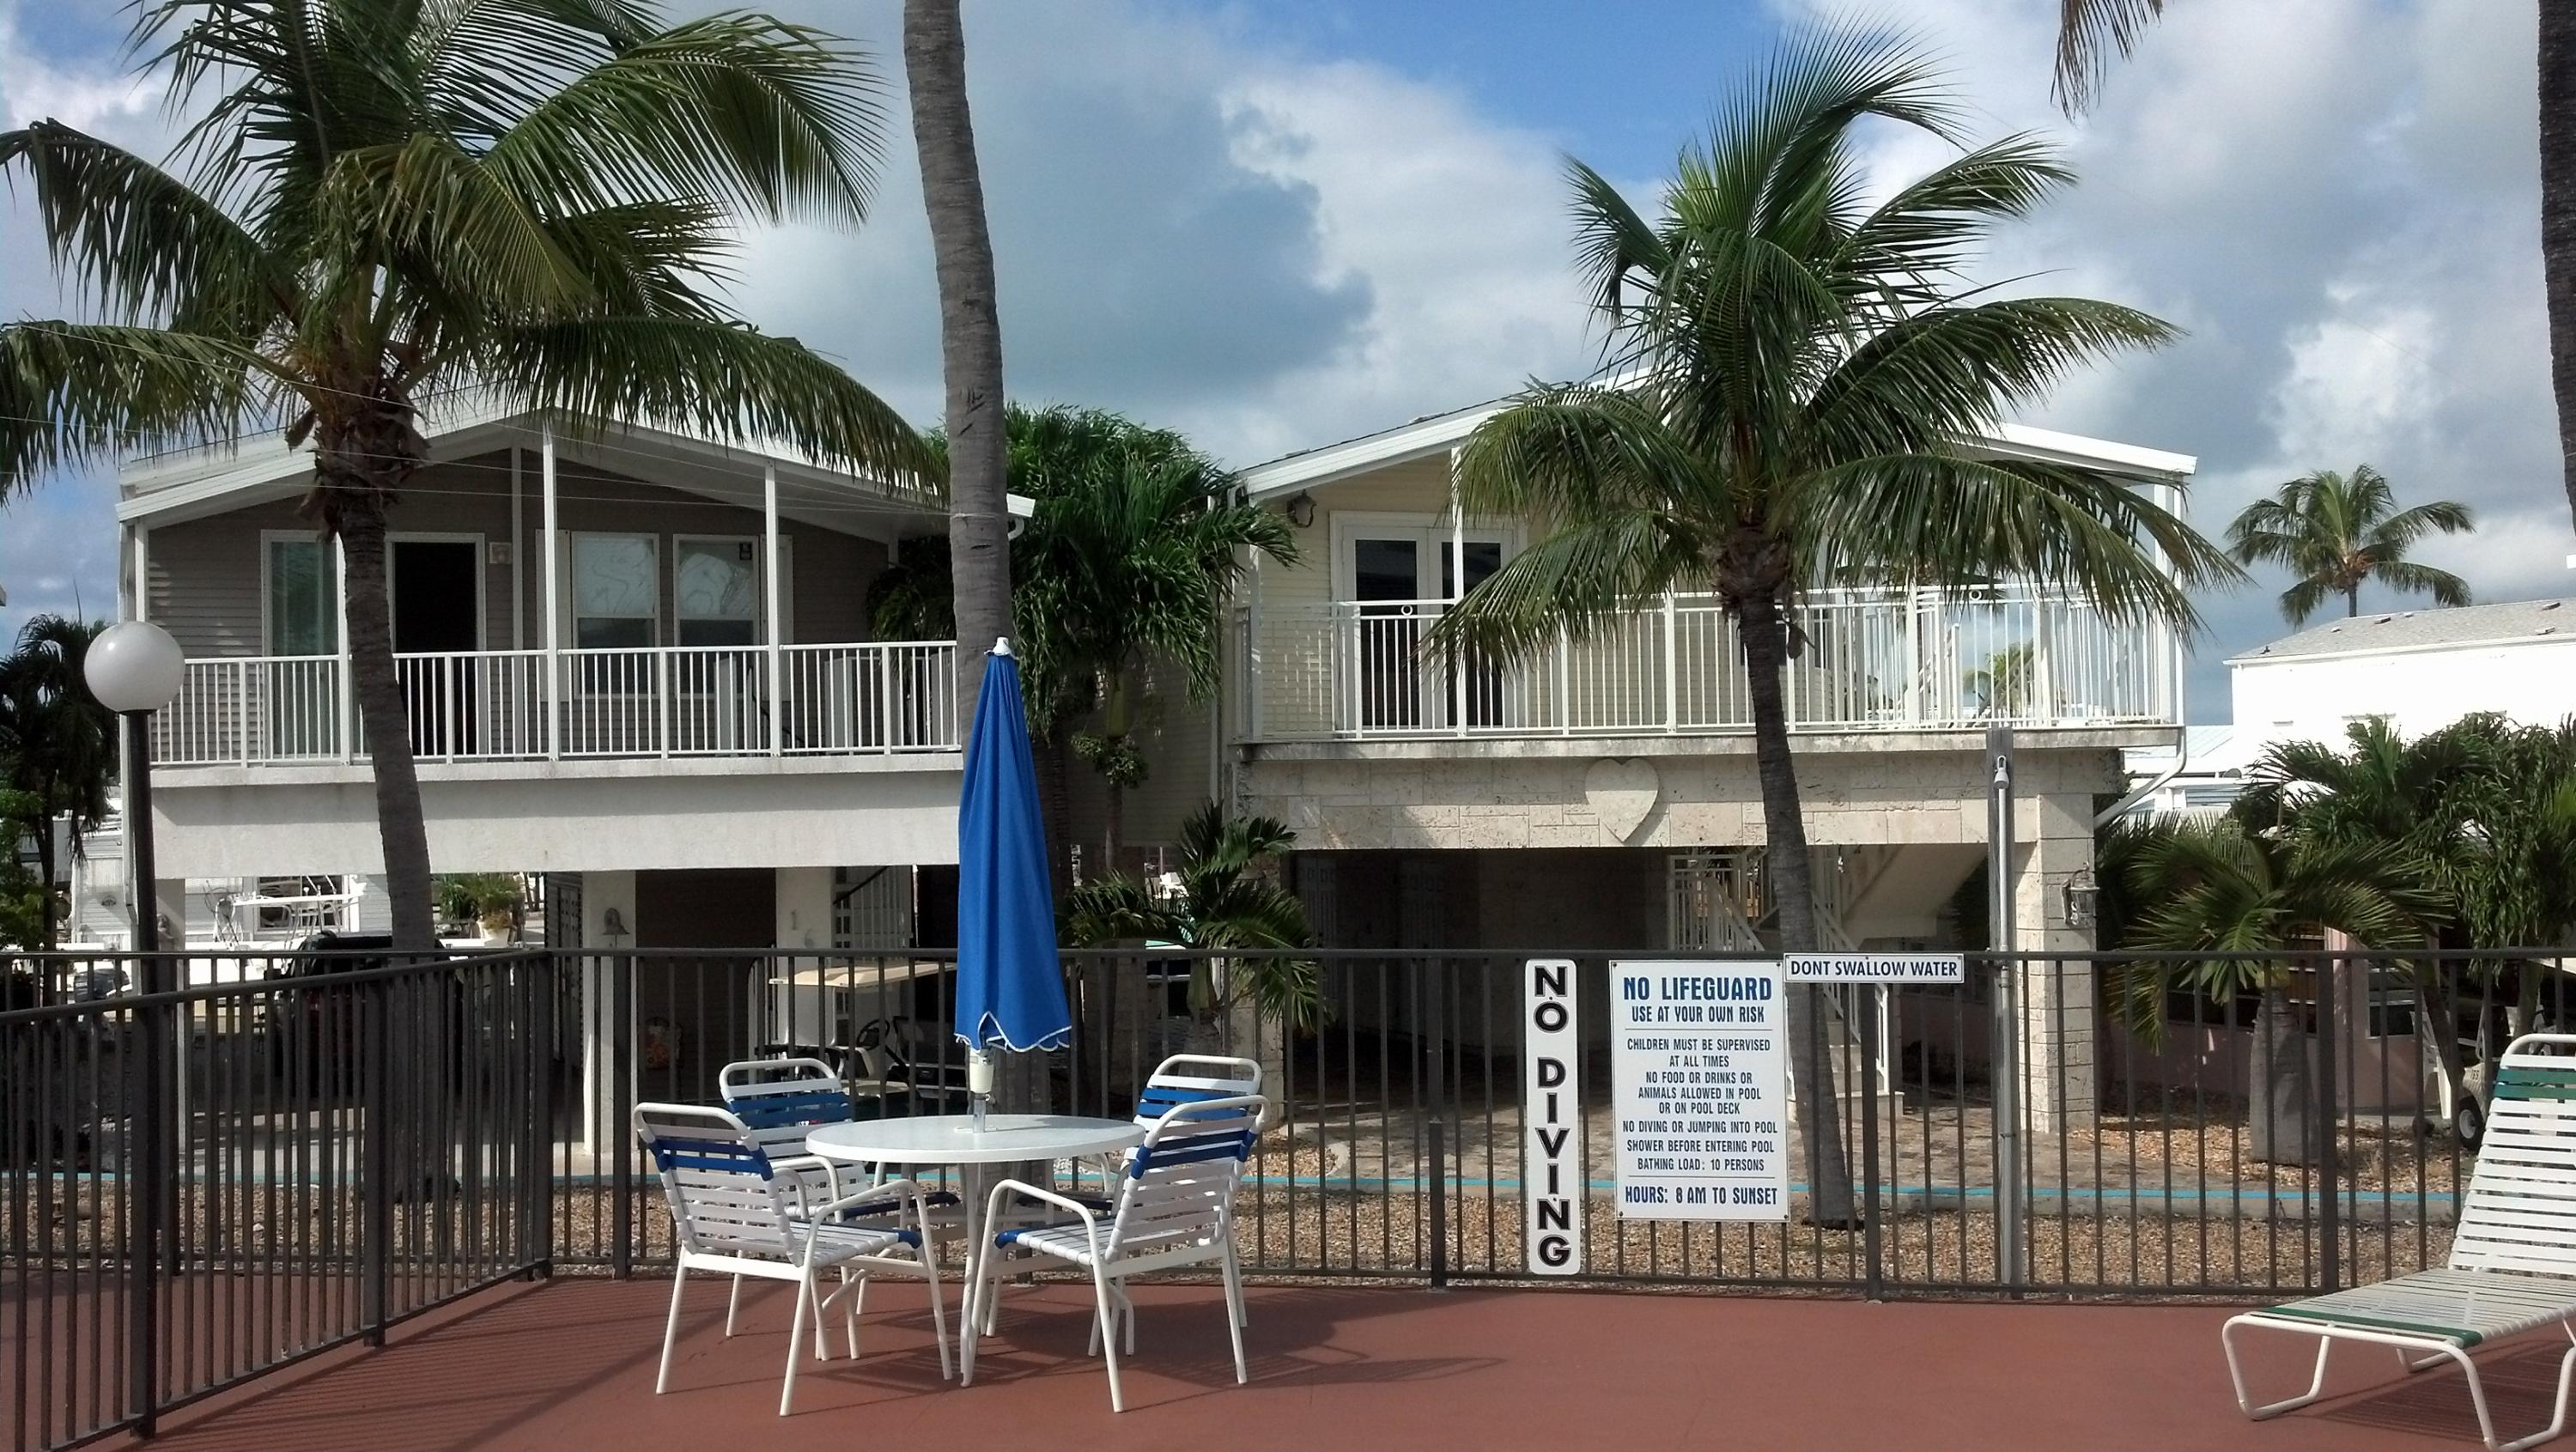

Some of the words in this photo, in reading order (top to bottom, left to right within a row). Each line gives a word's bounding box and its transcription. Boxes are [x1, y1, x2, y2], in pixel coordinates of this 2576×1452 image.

[1791, 961, 1830, 975] DONT
[1835, 961, 1905, 975] SWALLOW
[1911, 962, 1957, 975] WATER
[1624, 977, 1649, 999] NO
[1662, 977, 1771, 1000] LIFEGUARD
[1534, 966, 1569, 1033] NO
[1632, 1006, 1652, 1022] USE
[1658, 1006, 1669, 1022] AT
[1675, 1006, 1703, 1022] YOUR
[1709, 1006, 1733, 1022] OWN
[1740, 1006, 1764, 1023] RISK
[1628, 1038, 1668, 1050] CHILDREN
[1674, 1039, 1697, 1050] MUST
[1703, 1039, 1712, 1050] BE
[1717, 1039, 1770, 1050] SUPERVISED
[1670, 1055, 1679, 1066] AT
[1684, 1055, 1698, 1066] ALL
[1703, 1055, 1728, 1067] TIMES
[1646, 1072, 1657, 1083] NO
[1662, 1072, 1684, 1083] FOOD
[1689, 1072, 1700, 1083] OR
[1705, 1072, 1735, 1084] DRINKS
[1741, 1072, 1752, 1084] OR
[1638, 1087, 1676, 1098] ANIMALS
[1681, 1088, 1721, 1099] ALLOWED
[1726, 1088, 1734, 1099] IN
[1739, 1088, 1761, 1099] POOL
[1659, 1103, 1670, 1114] OR
[1675, 1103, 1686, 1114] ON
[1692, 1103, 1713, 1114] POOL
[1717, 1103, 1740, 1114] DECK
[1623, 1121, 1634, 1132] NO
[1639, 1121, 1667, 1132] DIVING
[1672, 1121, 1683, 1133] OR
[1687, 1121, 1726, 1133] JUMPING
[1731, 1121, 1750, 1133] INTO
[1755, 1121, 1777, 1133] POOL
[1627, 1140, 1663, 1151] SHOWER
[1668, 1140, 1701, 1151] BEFORE
[1705, 1140, 1747, 1151] ENTERING
[1752, 1141, 1774, 1152] POOL
[1535, 1057, 1571, 1267] DIVING
[1638, 1158, 1674, 1169] BATHING
[1679, 1158, 1704, 1169] LOAD:
[1711, 1159, 1720, 1170] 10
[1725, 1159, 1764, 1170] PERSONS
[1625, 1187, 1668, 1203] HOURS:
[1676, 1188, 1682, 1203] 8
[1687, 1187, 1706, 1204] AM
[1712, 1188, 1726, 1204] TO
[1733, 1188, 1777, 1205] SUNSET
